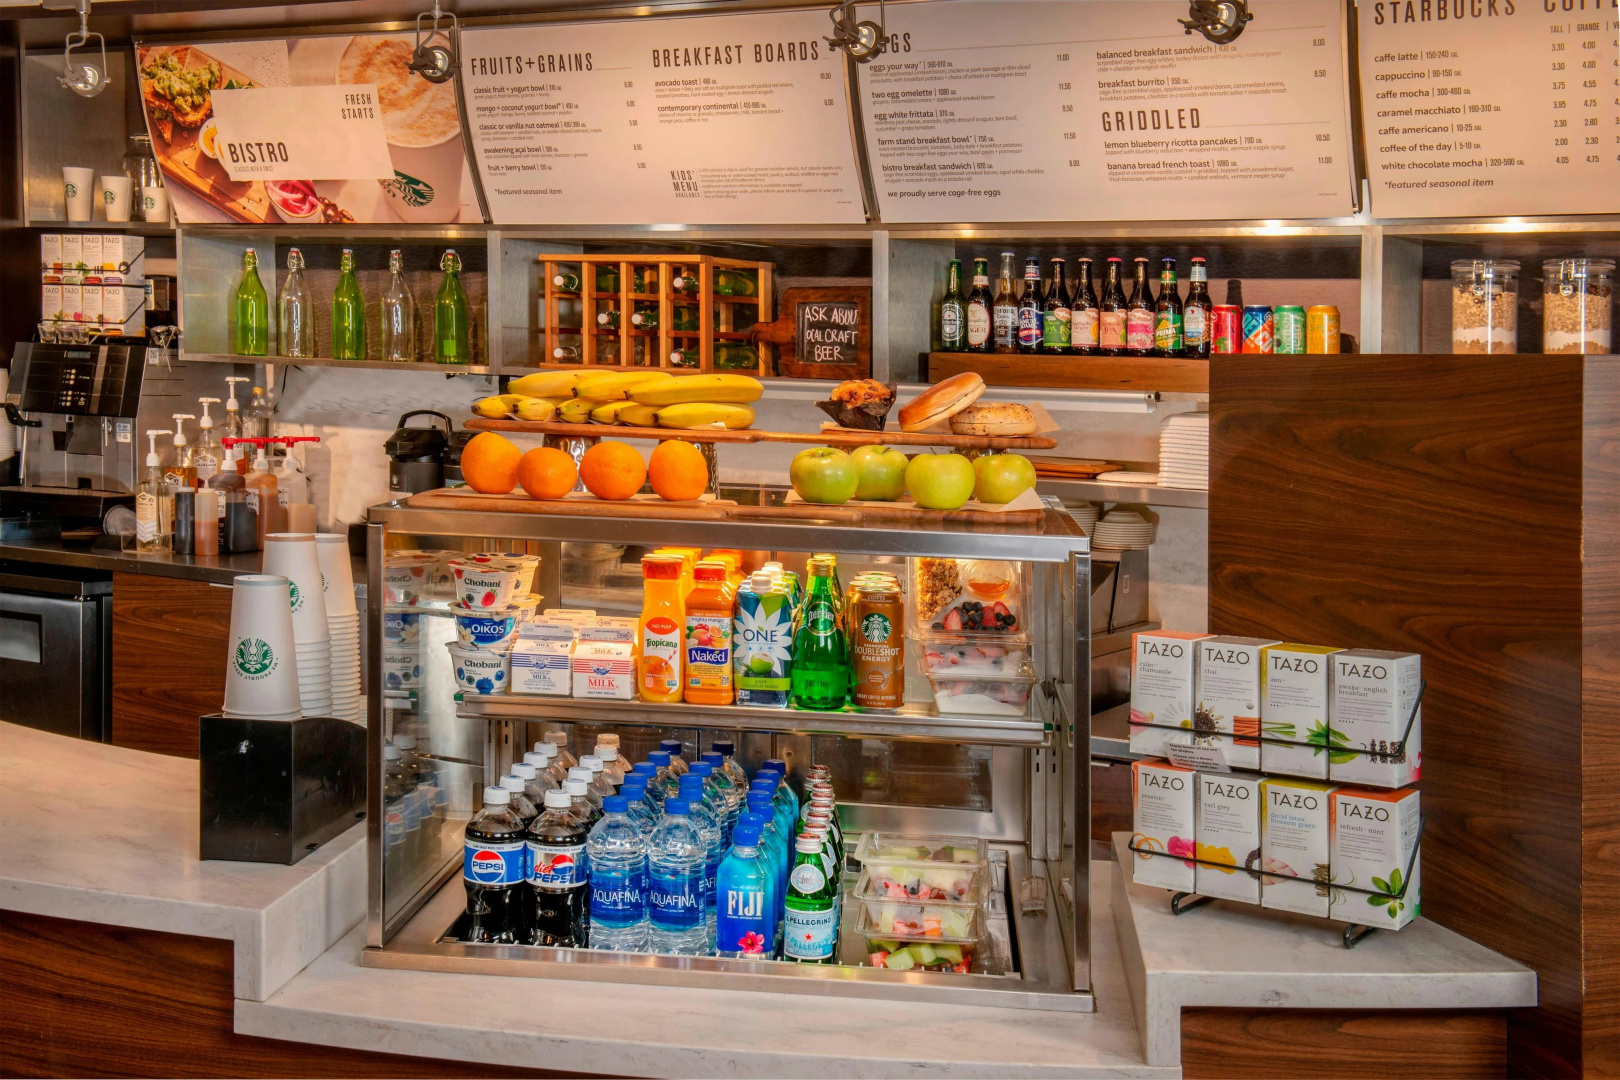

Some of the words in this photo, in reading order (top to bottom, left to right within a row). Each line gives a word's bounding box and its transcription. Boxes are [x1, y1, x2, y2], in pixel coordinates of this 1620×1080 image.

[1375, 0, 1515, 25] STARBUCKS
[1550, 25, 1564, 33] TALL
[1576, 23, 1600, 31] GRANDE
[652, 45, 743, 68] BREAKFAST
[754, 40, 819, 63] BOARDS
[1096, 50, 1132, 59] balanced
[1134, 47, 1172, 57] breakfast
[1174, 45, 1212, 55] sandwich
[1374, 53, 1396, 62] caffe
[1398, 52, 1418, 61] latte
[1426, 50, 1449, 59] 150-240
[1552, 43, 1564, 51] 3.30
[1582, 41, 1596, 49] 4.00
[471, 52, 593, 76] FRUITS+GRAINS
[1375, 71, 1425, 82] cappuccino
[1432, 69, 1452, 78] 90-150
[1552, 62, 1565, 70] 3.30
[1582, 61, 1596, 69] 4.00
[654, 79, 681, 87] avocado
[681, 78, 698, 86] toast
[1098, 79, 1136, 89] breakfast
[1137, 78, 1165, 87] burrito
[872, 91, 885, 99] two
[886, 91, 900, 99] egg
[901, 90, 933, 98] omelette
[1376, 90, 1397, 99] caffe
[1400, 88, 1429, 98] mocha
[1583, 80, 1597, 88] 4.55
[345, 93, 372, 105] FRESH
[341, 108, 374, 119] STARTS
[657, 104, 701, 113] contemporary
[702, 102, 739, 111] continental
[1377, 108, 1412, 117] caramel
[1415, 106, 1461, 116] macchiato
[1468, 104, 1491, 113] 190-310
[1584, 99, 1597, 107] 4.75
[874, 112, 888, 121] egg
[888, 111, 908, 119] white
[909, 110, 934, 118] frittata
[1101, 108, 1200, 132] GRIDDLED
[1378, 126, 1399, 135] caffe
[1402, 125, 1449, 134] americano
[1457, 124, 1473, 132] 10-25
[1554, 119, 1567, 127] 2.30
[1584, 118, 1598, 126] 2.80
[1104, 141, 1129, 149] lemon
[1131, 139, 1169, 149] blueberry
[1171, 138, 1198, 147] ricotta
[1199, 137, 1238, 147] pancakes
[1380, 144, 1406, 153] coffee
[1408, 143, 1417, 152] of
[1419, 143, 1434, 151] the
[1436, 142, 1452, 153] day
[1459, 142, 1472, 150] 5-10
[1555, 138, 1568, 146] 2.00
[228, 142, 289, 163] BISTRO
[1107, 162, 1136, 170] banana
[1138, 161, 1160, 169] bread
[1162, 161, 1188, 169] french
[1189, 160, 1210, 168] toast
[1381, 161, 1405, 170] white
[1407, 160, 1450, 169] chocolate
[1452, 159, 1483, 168] mocha
[1490, 157, 1515, 167] 320-500
[1556, 156, 1569, 164] 4.05
[1586, 155, 1600, 163] 4.75
[672, 181, 698, 192] MENU
[1429, 179, 1470, 188] seasonal
[1473, 179, 1494, 187] item
[899, 189, 926, 199] proudly
[948, 189, 982, 199] cage-free
[983, 190, 1001, 198] eggs
[805, 306, 828, 322] ASK
[1104, 326, 1117, 334] IPA
[1156, 327, 1177, 337] PRIMA
[824, 329, 858, 345] CRAFT
[814, 344, 844, 362] BEER
[464, 577, 502, 588] Chobani
[471, 623, 505, 634] OIKOS
[743, 629, 779, 642] ONE
[645, 638, 678, 649] Tropicana
[854, 646, 901, 657] DOUBLESHOT
[1140, 641, 1184, 659] TAZO
[1204, 647, 1251, 665] TAZO
[464, 660, 502, 669] Chobani
[1271, 656, 1319, 673] TAZO
[244, 672, 272, 681] PROUDLY
[1140, 667, 1171, 676] chamomile
[1338, 662, 1388, 680] TAZO
[588, 679, 615, 687] MILK
[1338, 689, 1368, 698] breakfast
[1363, 685, 1388, 695] english
[1141, 772, 1185, 791] TAZO
[1204, 781, 1250, 800] TAZO
[1271, 791, 1318, 810] TAZO
[1217, 804, 1231, 812] grey
[1340, 802, 1389, 822] TAZO
[1270, 811, 1288, 820] decaf
[1288, 814, 1305, 822] lotus
[1270, 817, 1297, 826] blossom
[1298, 821, 1317, 830] green
[1340, 824, 1363, 833] refresh
[1368, 828, 1385, 836] mint
[472, 861, 504, 871] PEPSI
[533, 861, 556, 874] diet
[533, 873, 575, 885] PEPSI
[592, 888, 642, 905] AQUAFINA
[649, 890, 697, 908] AQUAFINA
[727, 890, 764, 917] FIJI
